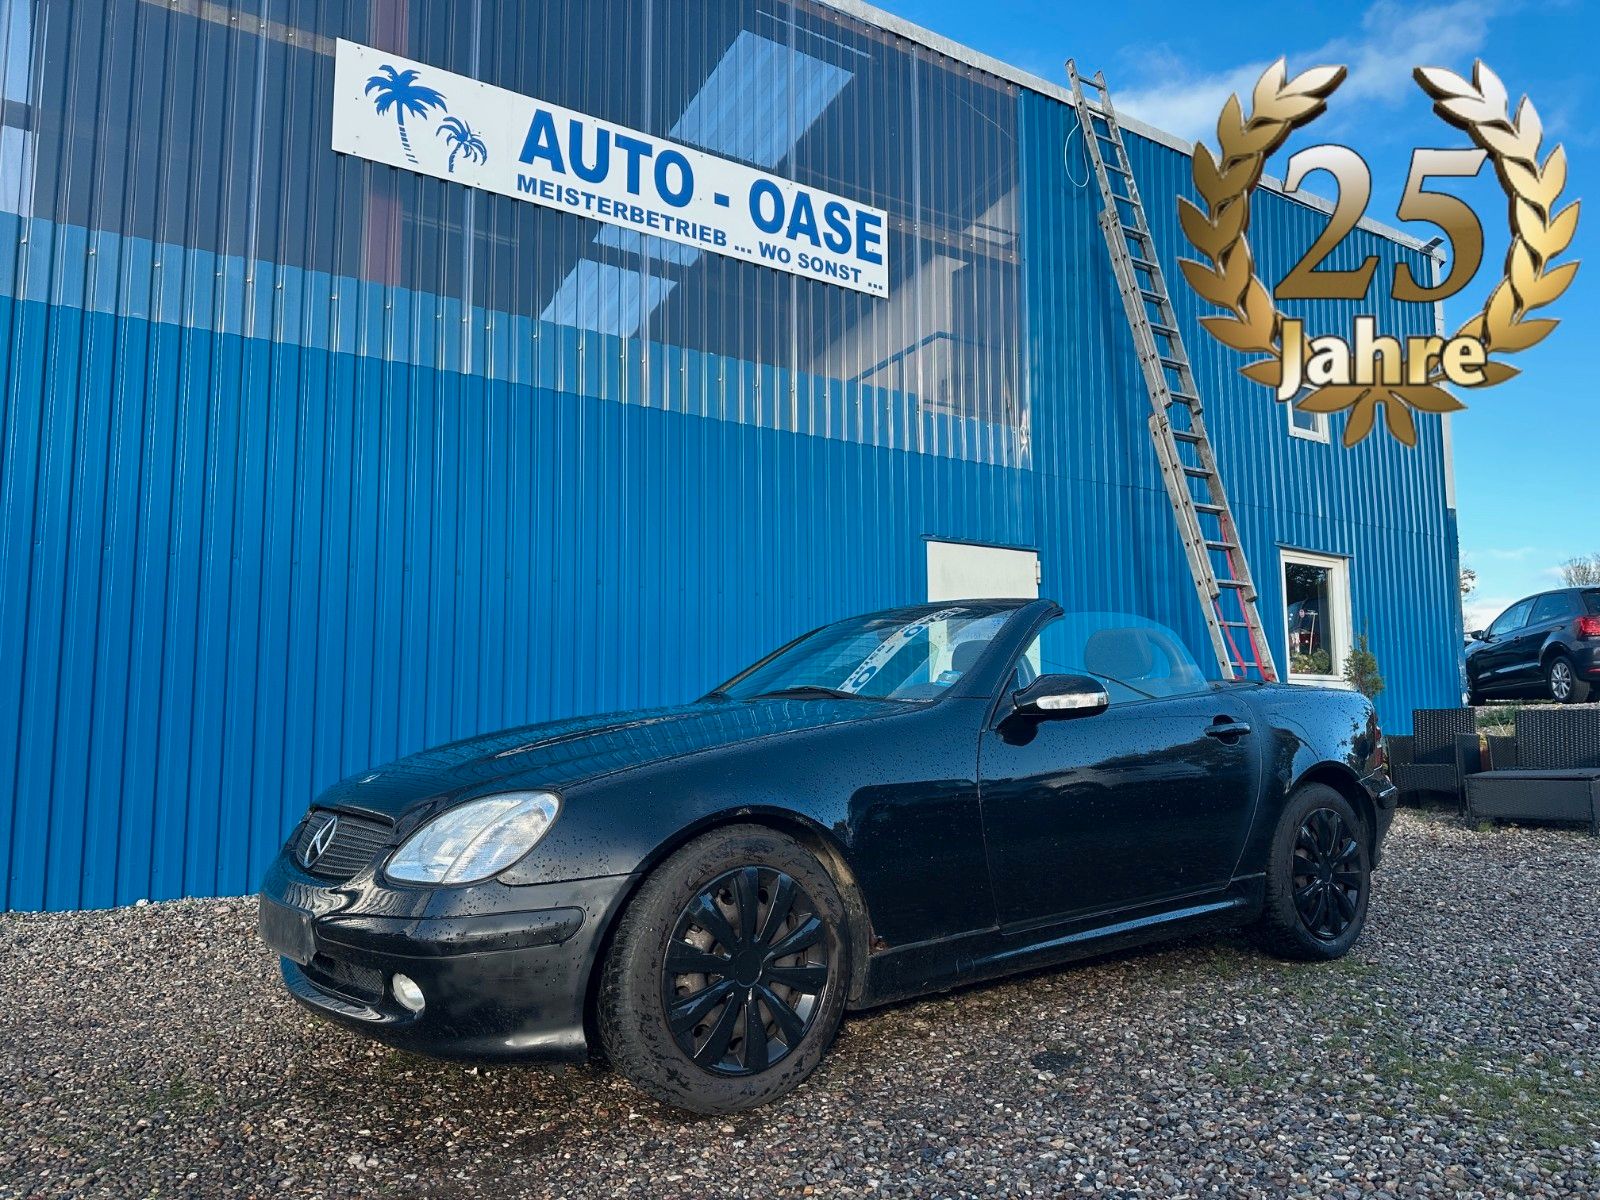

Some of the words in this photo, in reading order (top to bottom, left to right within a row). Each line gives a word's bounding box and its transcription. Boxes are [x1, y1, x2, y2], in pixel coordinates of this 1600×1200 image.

[517, 173, 727, 247] MEISTERBETRIEB
[734, 245, 755, 255] ...
[758, 240, 792, 264] WO
[797, 252, 862, 284] SONST
[867, 282, 883, 291] ...
[518, 108, 695, 208] AUTO
[713, 191, 730, 208] -
[748, 178, 883, 266] OASE
